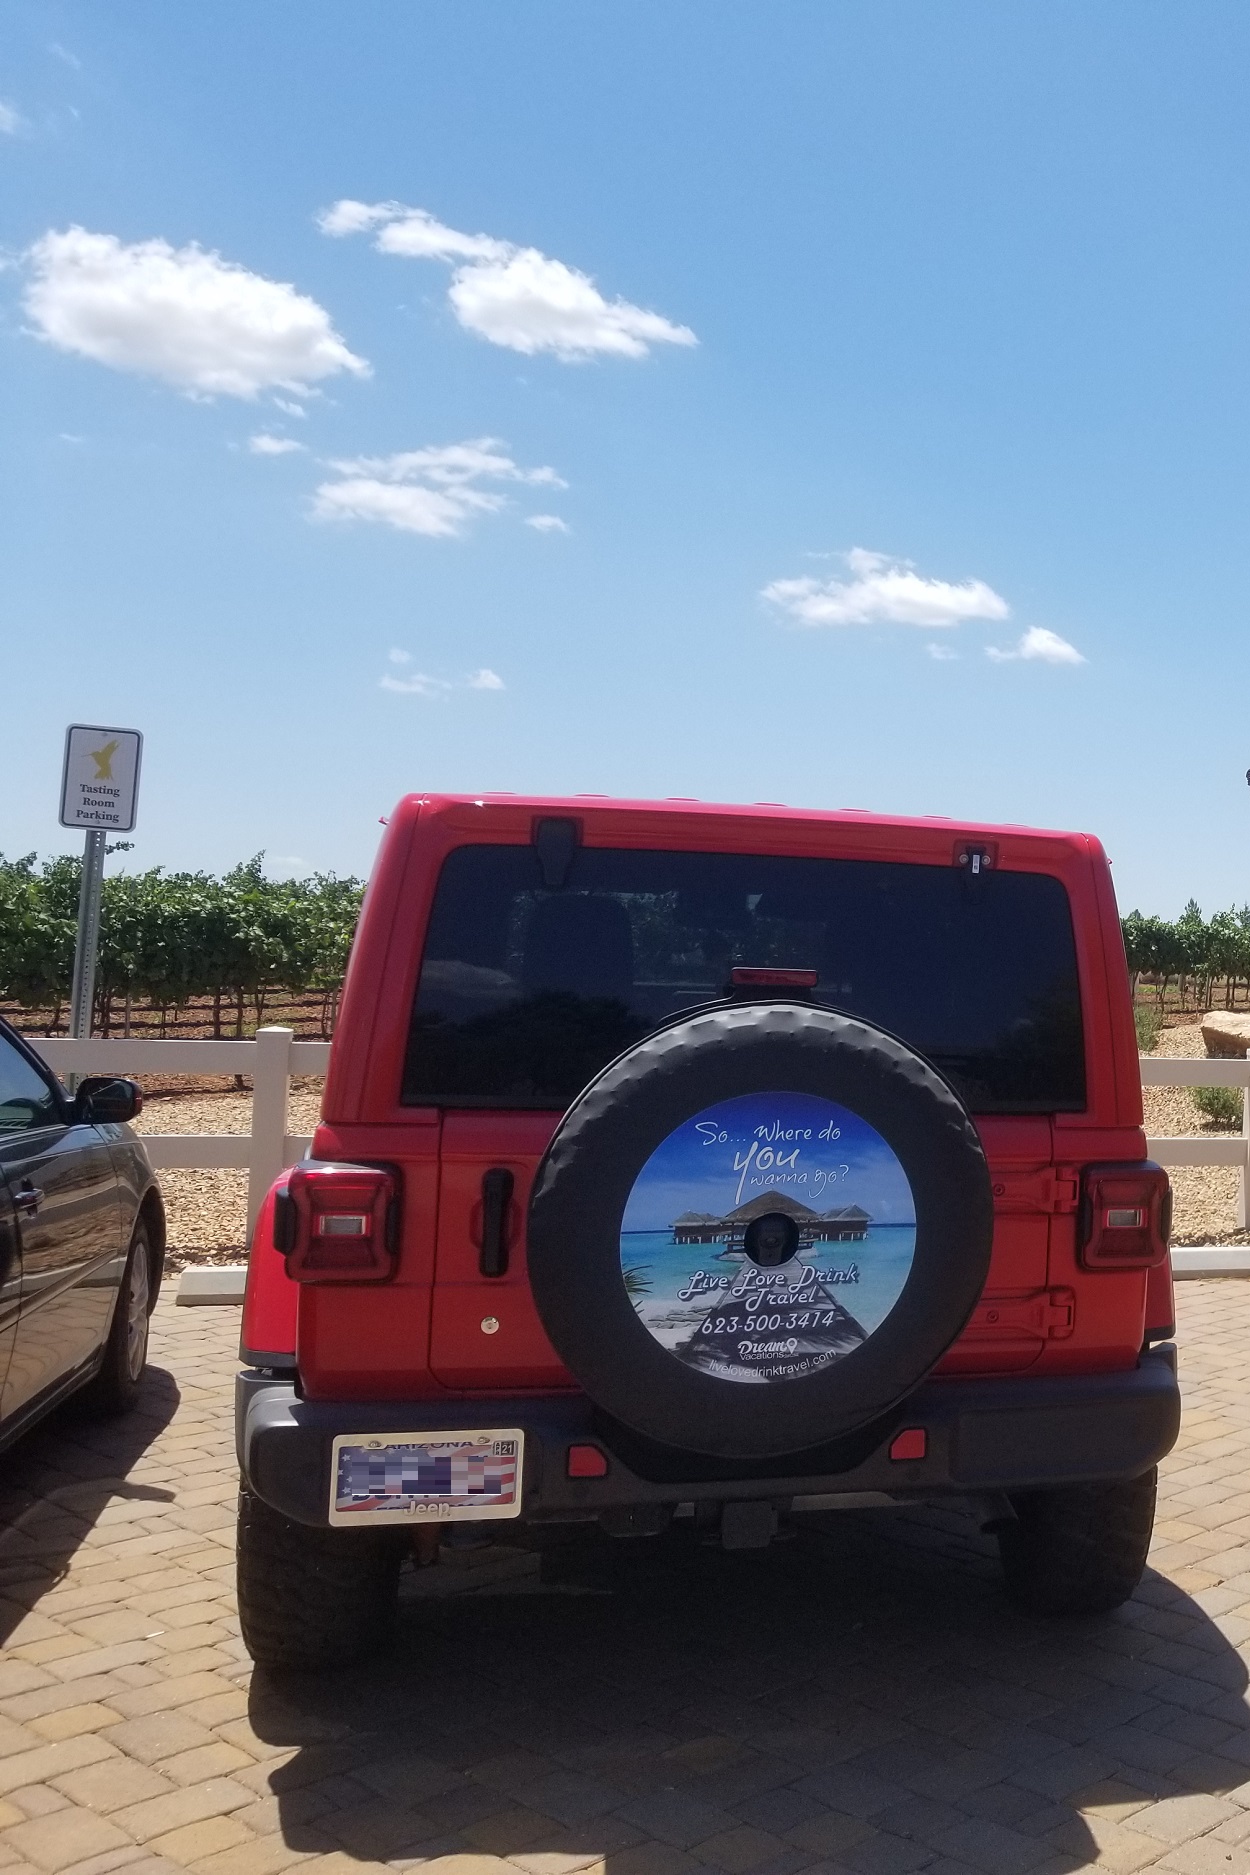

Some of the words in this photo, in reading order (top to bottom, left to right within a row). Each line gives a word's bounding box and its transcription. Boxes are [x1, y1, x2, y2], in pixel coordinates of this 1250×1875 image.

[80, 783, 120, 798] Tasting
[82, 797, 115, 808] Room
[76, 809, 120, 823] Parking
[695, 1121, 747, 1146] So...
[818, 1119, 841, 1141] do
[749, 1169, 808, 1186] wanna
[808, 1164, 850, 1199] go?
[676, 1270, 729, 1301] Live
[731, 1268, 785, 1297] Love
[788, 1263, 860, 1292] Drink
[744, 1287, 816, 1312] Travel
[701, 1310, 834, 1335] 623-500-3414
[737, 1341, 788, 1355] Dream
[708, 1349, 837, 1378] livelovedrinktravel.com
[501, 1444, 514, 1454] 21
[403, 1500, 451, 1517] Jeep
